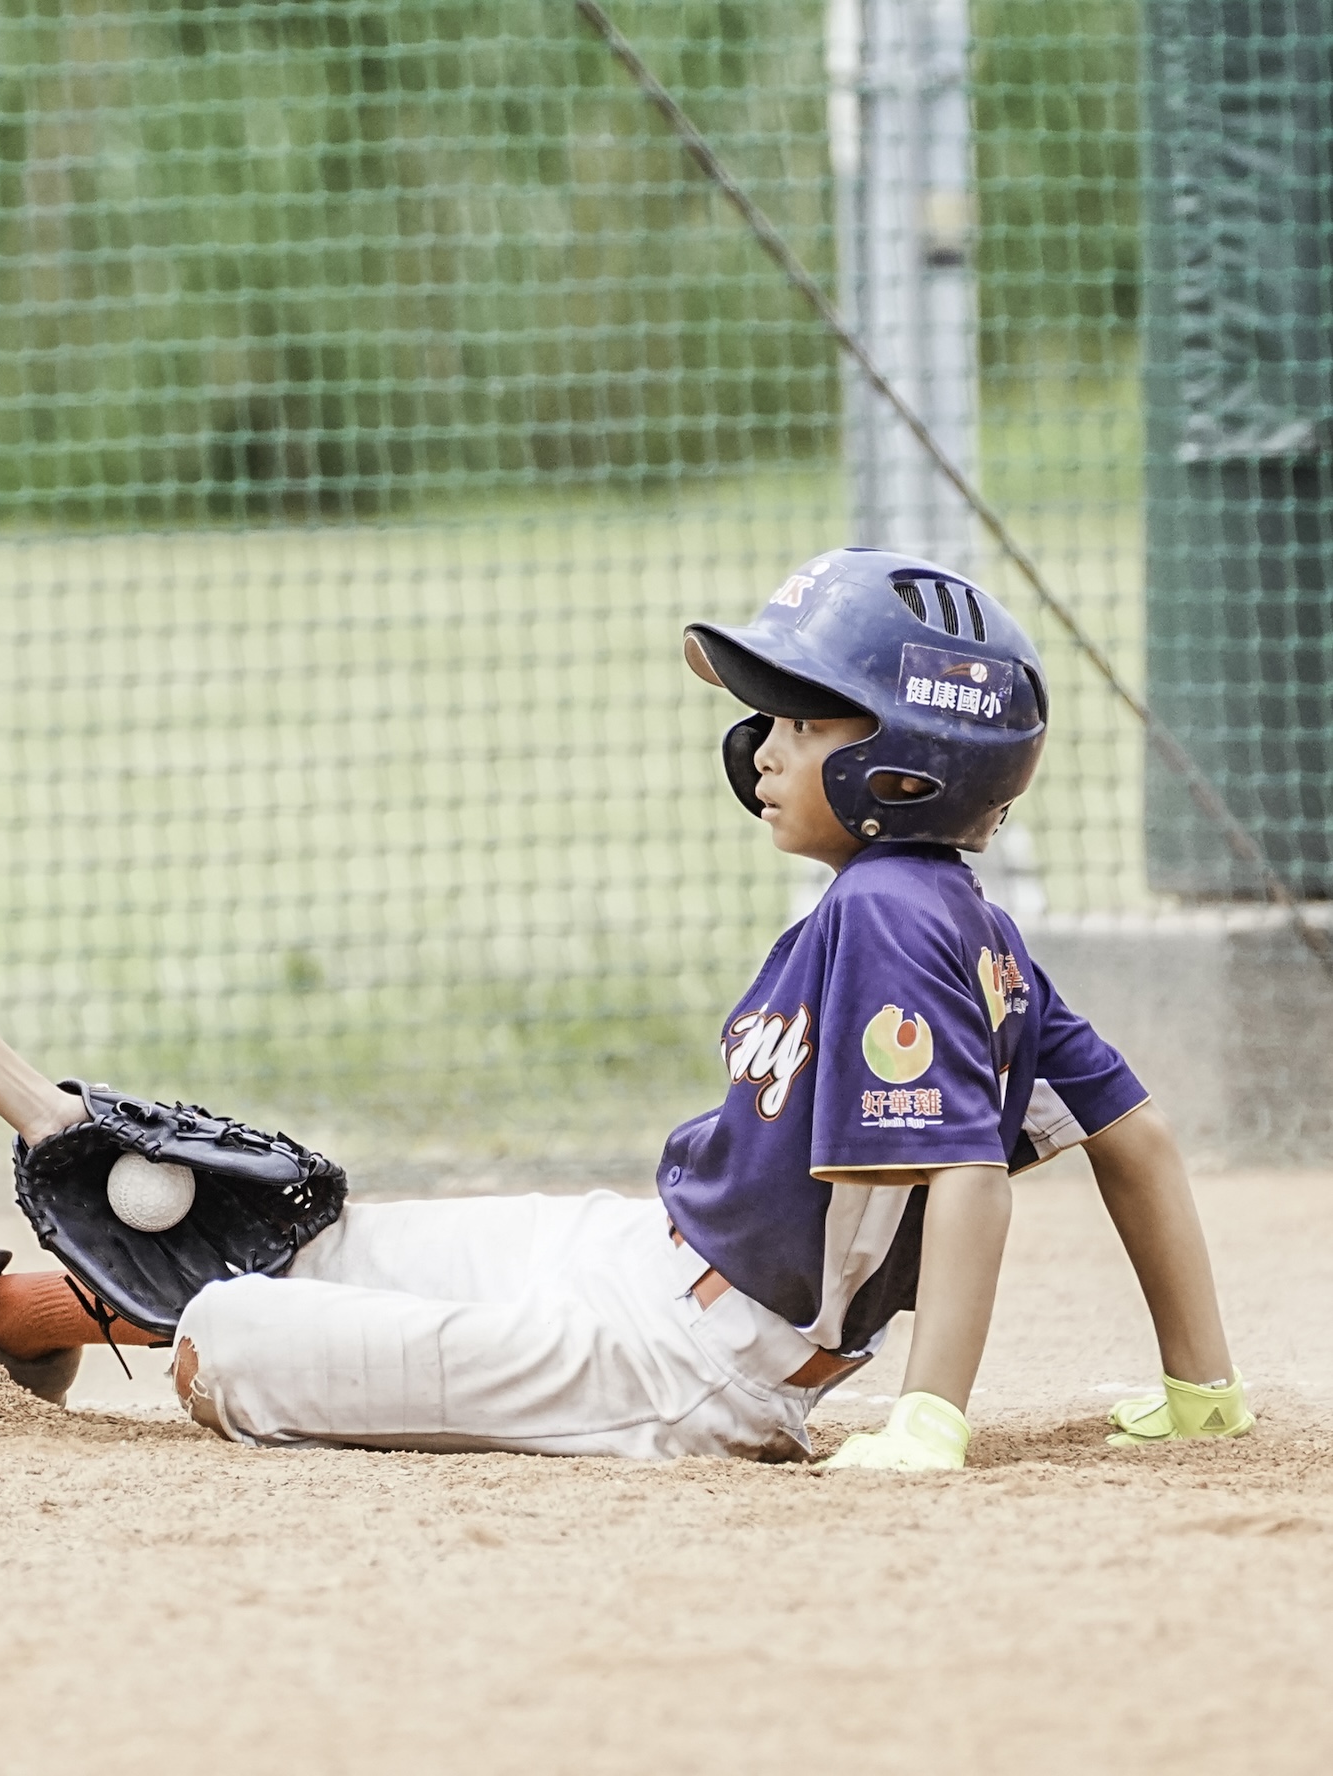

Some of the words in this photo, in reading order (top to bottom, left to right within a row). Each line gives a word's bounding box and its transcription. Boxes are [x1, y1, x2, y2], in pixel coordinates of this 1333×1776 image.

[906, 676, 1002, 719] 健康國小
[861, 1088, 943, 1118] 好華雞
